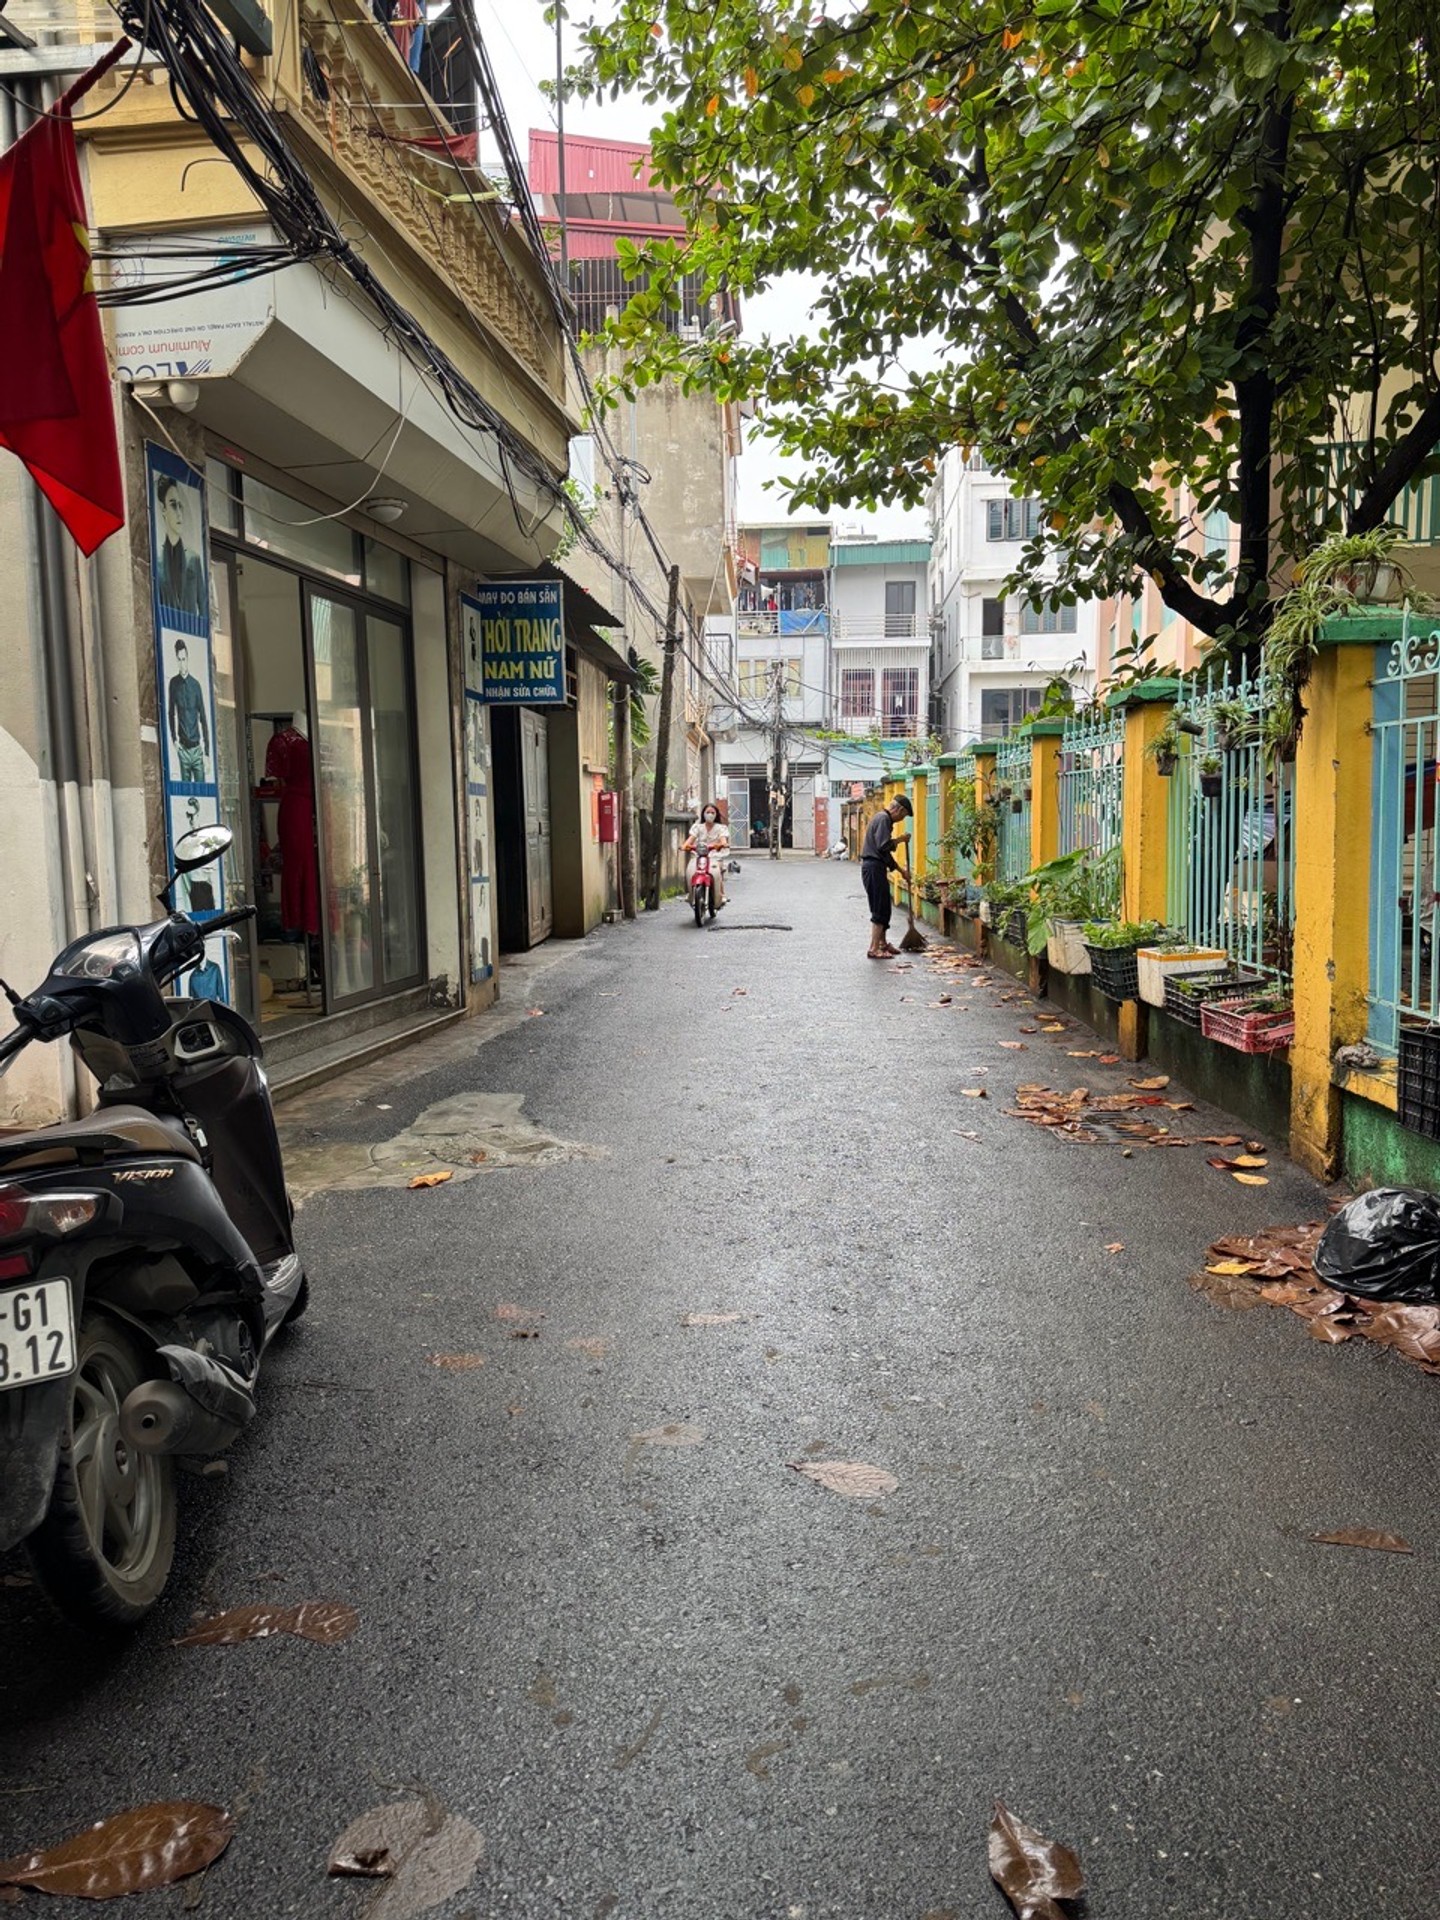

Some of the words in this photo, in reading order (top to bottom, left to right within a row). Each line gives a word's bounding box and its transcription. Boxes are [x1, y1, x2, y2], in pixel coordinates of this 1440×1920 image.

[149, 339, 211, 354] Aluminum
[517, 588, 537, 604] BÁN
[514, 618, 561, 652] TRANG
[484, 661, 524, 679] NAM
[529, 656, 557, 679] NỮ
[485, 685, 511, 699] NHẬN
[513, 683, 531, 697] SỬA
[533, 684, 557, 697] CHỮA
[112, 1169, 174, 1184] VISION
